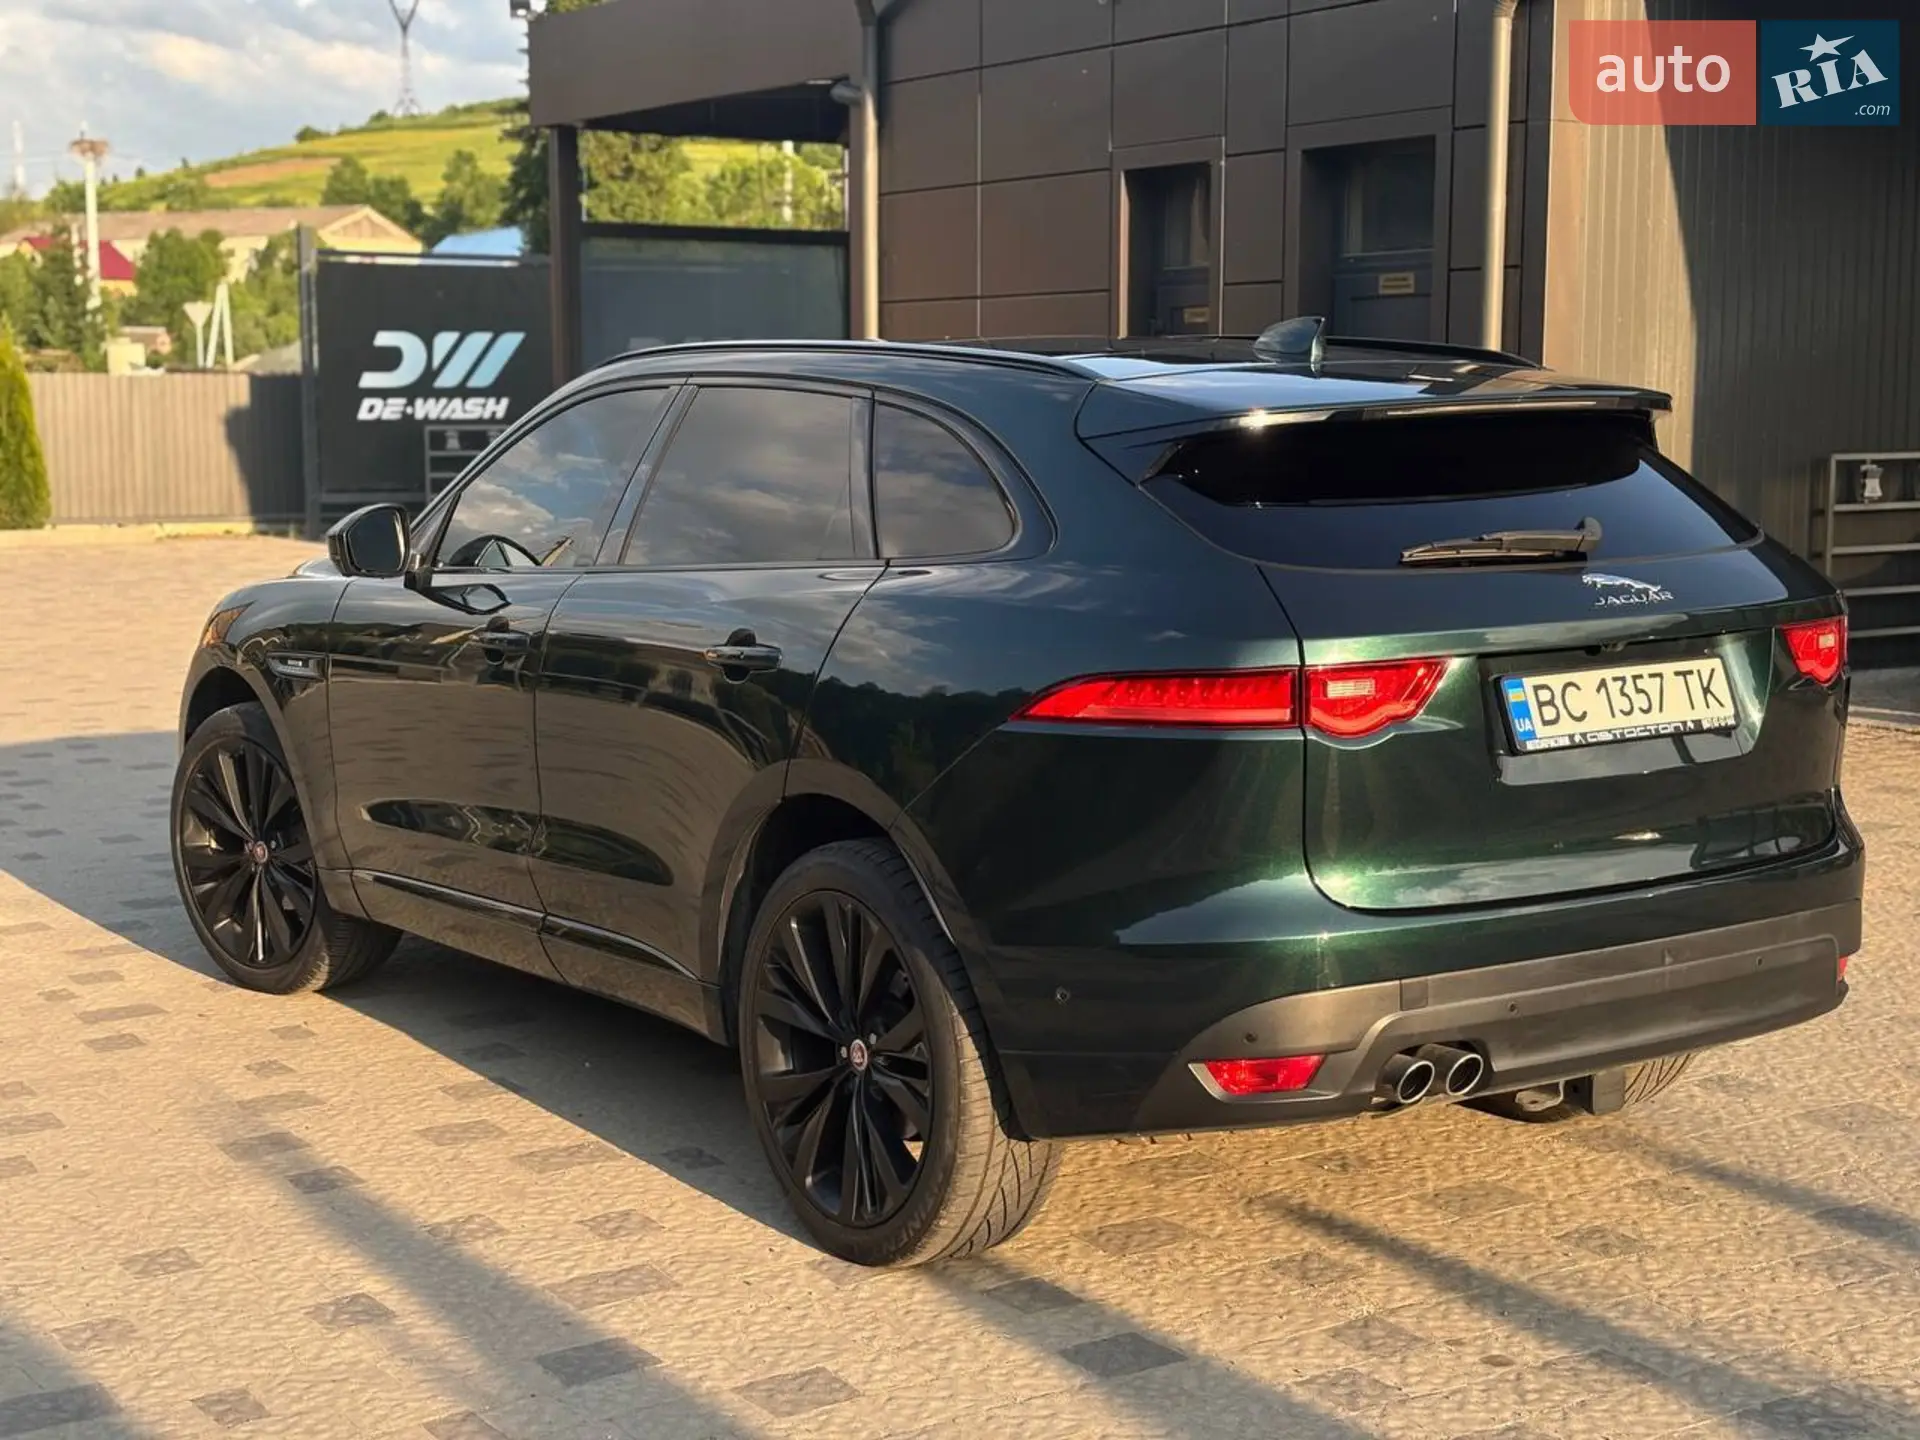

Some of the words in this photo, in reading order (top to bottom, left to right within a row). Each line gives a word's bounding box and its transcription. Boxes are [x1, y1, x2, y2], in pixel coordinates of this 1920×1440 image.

[1595, 590, 1674, 607] JAGUAR
[1532, 681, 1588, 727] BC
[1595, 672, 1665, 719] 1357
[1673, 667, 1725, 711] TK
[1515, 717, 1534, 733] UA
